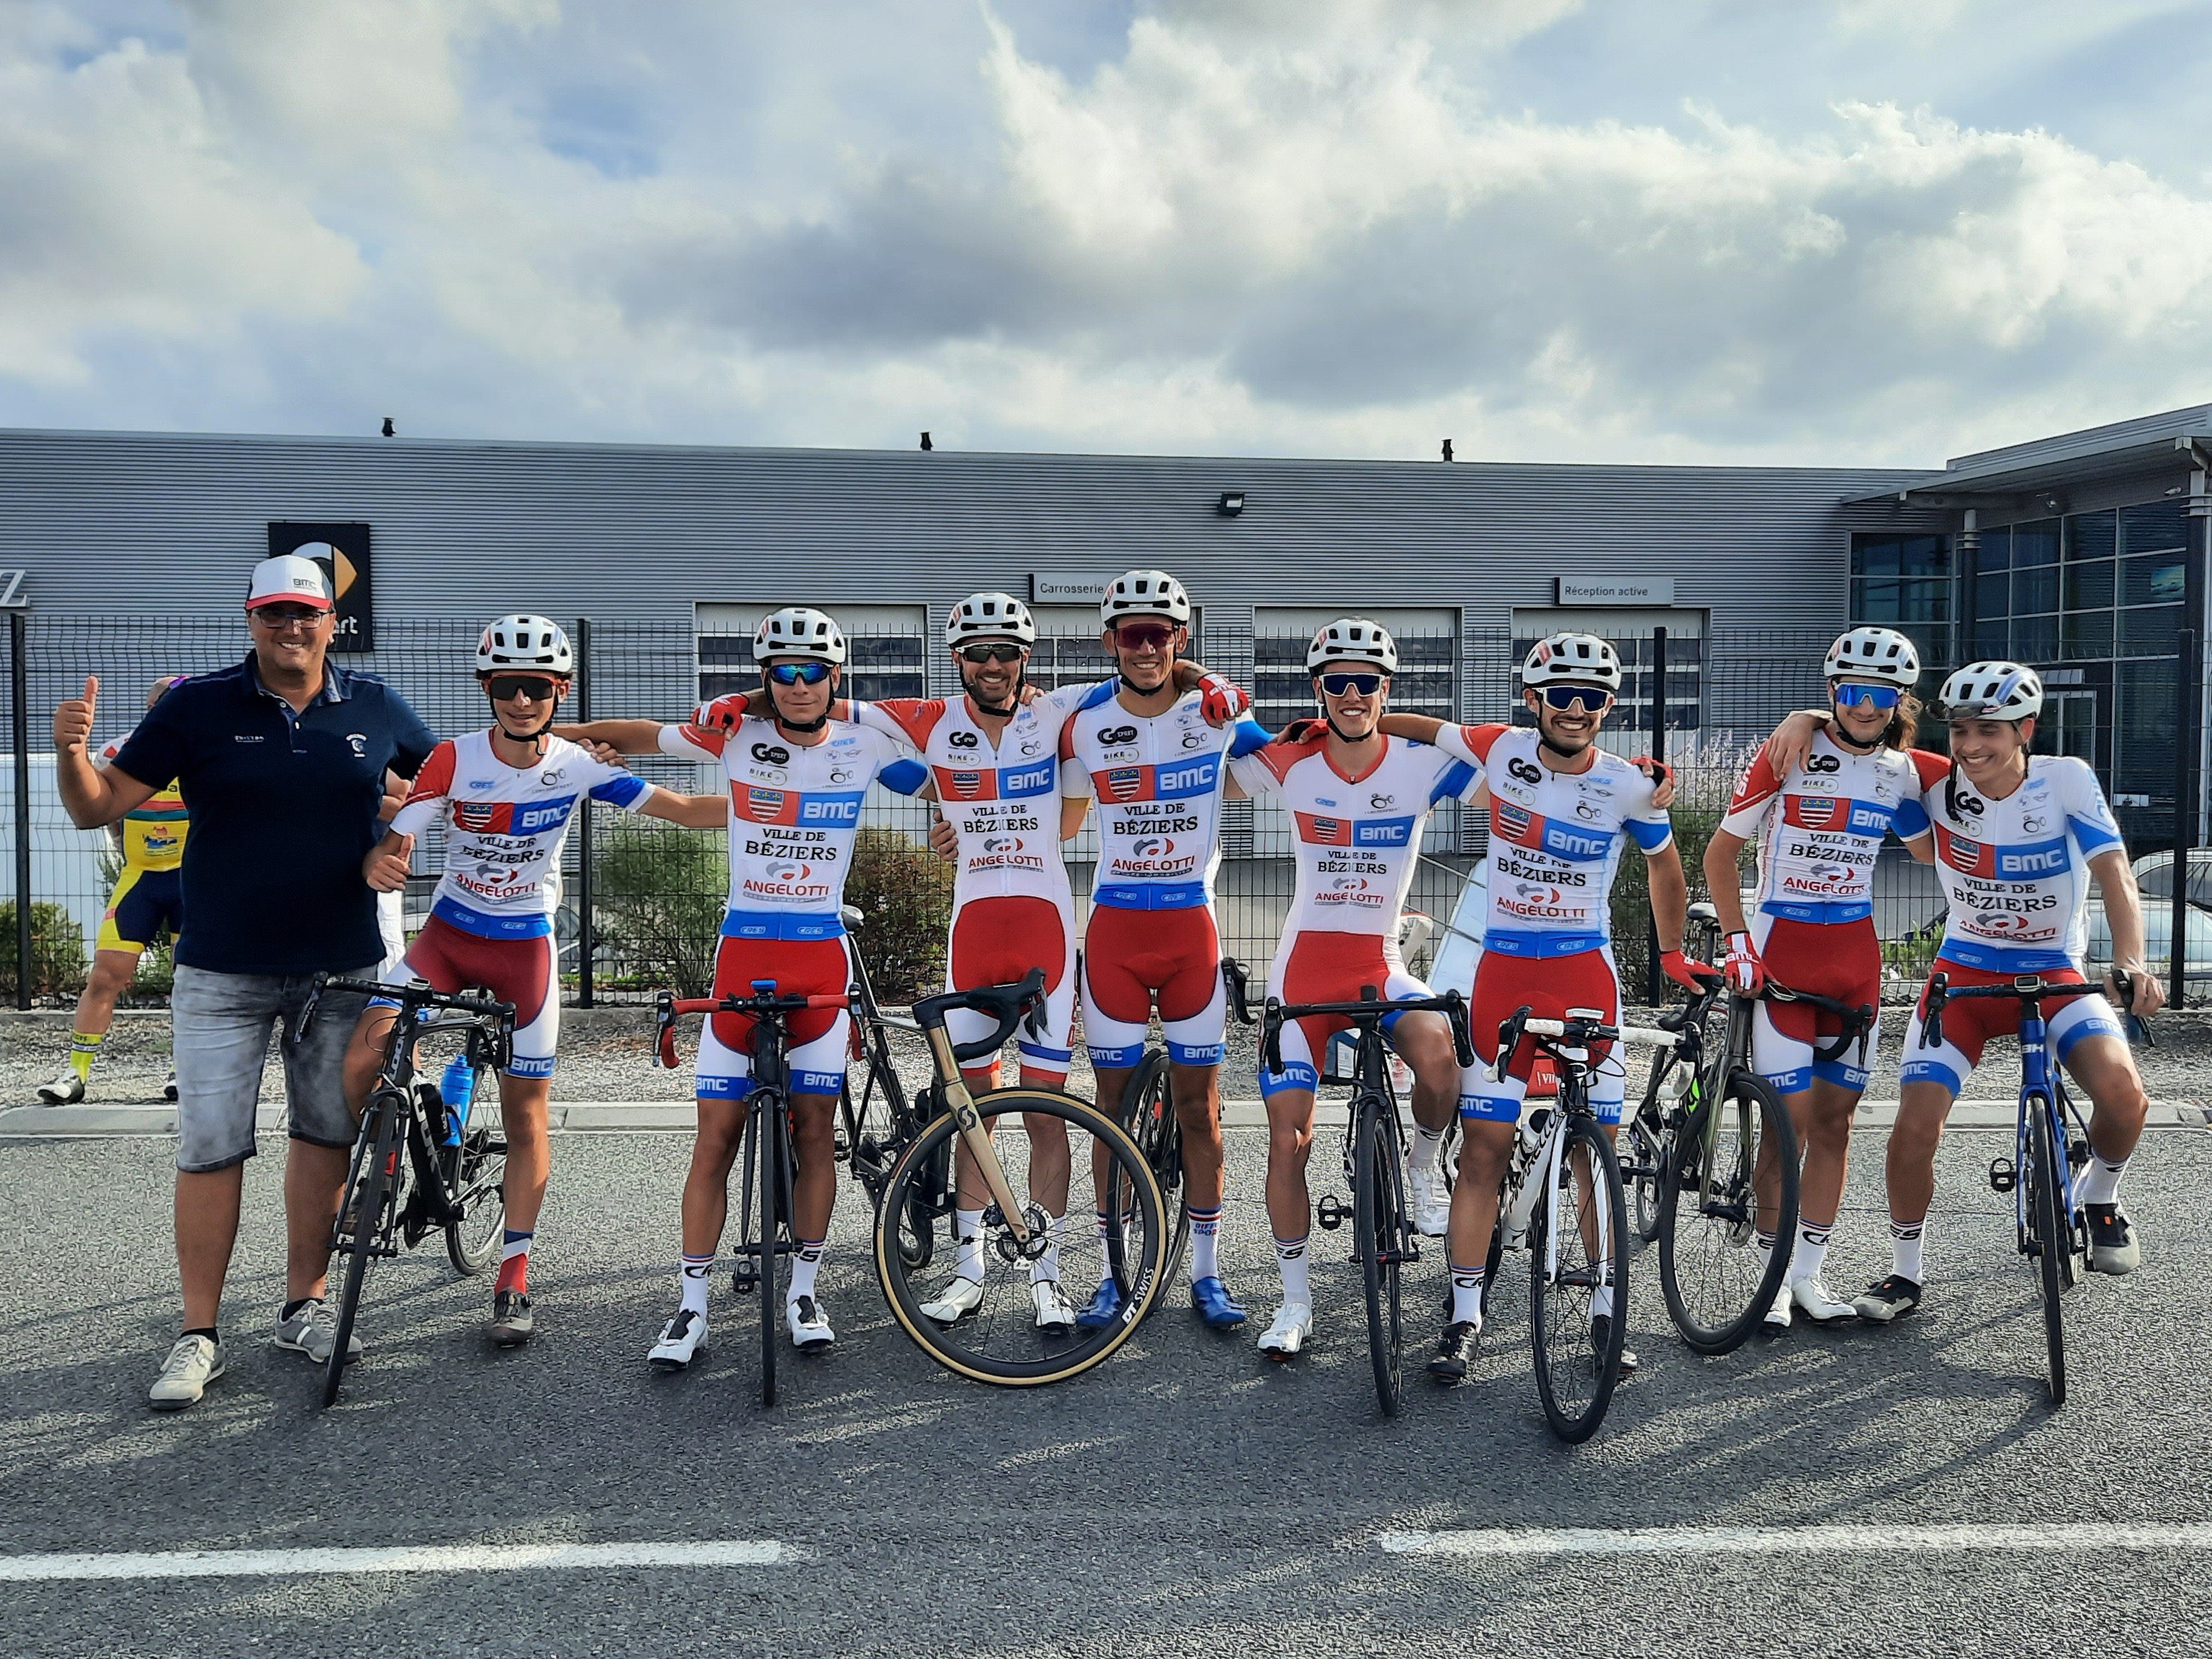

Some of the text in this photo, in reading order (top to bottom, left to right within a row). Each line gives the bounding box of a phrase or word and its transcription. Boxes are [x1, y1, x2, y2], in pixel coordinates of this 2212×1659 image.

[293, 578, 318, 589] BMC
[1040, 583, 1104, 593] Carrosserie
[1565, 585, 1648, 598] Réception active
[750, 768, 773, 778] BIKE
[1007, 768, 1050, 791] BMC
[1159, 764, 1214, 791] BMC
[1502, 782, 1524, 796] BIKE
[521, 803, 571, 827] BMC
[803, 801, 858, 819] BMC
[972, 805, 1028, 816] VILLE DE
[1124, 803, 1185, 816] VILLE DE
[963, 817, 1038, 832] BÉZIERS
[1112, 816, 1198, 835] BÉZIERS
[1359, 825, 1404, 840] BMC
[477, 836, 513, 850] VILLE
[762, 828, 826, 842] VILLE DE
[1547, 829, 1606, 855] BMC
[1809, 833, 1870, 848] VILLE DE
[745, 840, 837, 860] BÉZIERS
[1328, 850, 1359, 859] VILLE
[1509, 847, 1546, 864] VILLE
[1789, 843, 1874, 865] BÉZIERS
[968, 855, 1043, 868] ANGELOTTI
[1111, 855, 1195, 871] ANGELOTTI
[1318, 860, 1387, 874] BÉZIERS
[2001, 849, 2064, 872] BMC
[1497, 857, 1586, 886] BÉZIERS
[455, 873, 536, 897] ANGELOTTI
[743, 879, 829, 896] ANGELOTTI
[1963, 877, 2036, 894] VILLE DE
[1315, 892, 1384, 904] ANGELOTTI
[1953, 886, 2057, 912] BÉZIERS
[1497, 896, 1584, 918] ANGELOTTI
[1089, 1048, 1123, 1061] BMC
[1184, 1046, 1220, 1059] BMC
[2021, 1044, 2044, 1054] BH
[510, 1057, 552, 1073] BMC
[803, 1073, 840, 1088] BMC
[1767, 1072, 1797, 1088] MC
[1843, 1068, 1869, 1085] BM
[1121, 1267, 1154, 1324] DT SWISS
